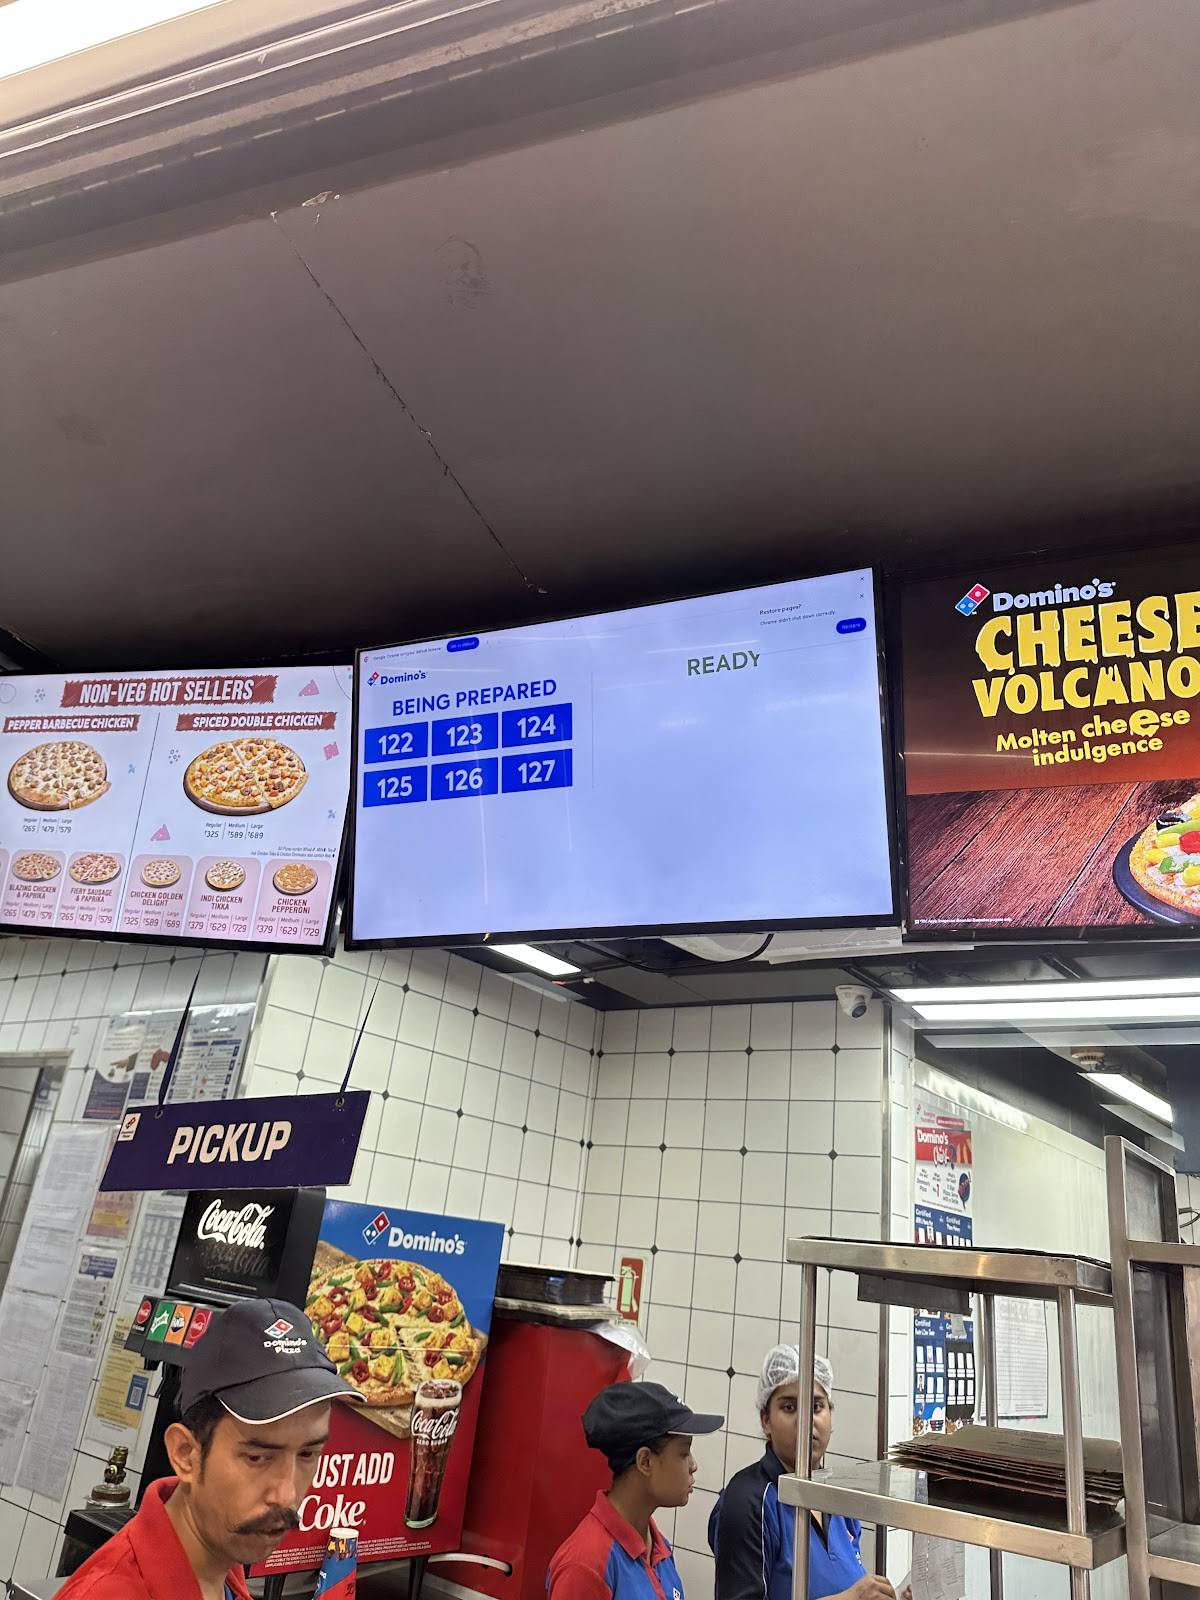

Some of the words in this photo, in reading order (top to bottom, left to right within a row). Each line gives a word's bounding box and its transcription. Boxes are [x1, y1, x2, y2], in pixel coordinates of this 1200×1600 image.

[992, 577, 1114, 612] Domino's
[975, 591, 1200, 675] CHEESE
[687, 650, 761, 676] READY
[380, 670, 426, 685] Domino's
[972, 655, 1200, 718] VOLCANO
[80, 682, 146, 703] NON-VEG
[150, 681, 181, 702] HOT
[184, 679, 255, 701] SELLERS
[393, 694, 450, 716] BEING
[456, 679, 557, 708] PREPARED
[8, 719, 41, 731] PEPPER
[42, 718, 90, 730] BARBECUE
[91, 717, 134, 728] CHICKEN
[192, 716, 230, 727] SPICED
[230, 715, 273, 727] DOUBLE
[274, 714, 323, 727] CHICKEN
[996, 728, 1077, 753] Molten
[1081, 707, 1190, 740] cheese
[378, 732, 414, 756] 122
[447, 723, 483, 747] 123
[517, 714, 556, 739] 124
[1032, 736, 1164, 767] indulgence
[377, 776, 413, 799] 125
[445, 768, 483, 792] 126
[518, 760, 556, 785] 127
[81, 895, 105, 903] PAPRIKA
[87, 889, 113, 897] SAUSAGE
[130, 891, 157, 899] CHICKEN
[158, 892, 184, 900] GOLDEN
[215, 895, 243, 903] CHICKEN
[277, 898, 308, 906] CHICKEN
[272, 905, 311, 914] PEPPERONI
[166, 1120, 292, 1165] PICKUP
[917, 1129, 949, 1145] Domino's
[197, 1199, 276, 1250] Coca-Cola
[388, 1227, 466, 1255] Domino's
[263, 1338, 308, 1348] Domino's
[275, 1346, 301, 1354] Pizza
[430, 1437, 448, 1446] SUGAR
[312, 1453, 354, 1488] UST
[352, 1452, 395, 1486] ADD
[297, 1494, 367, 1532] Coke
